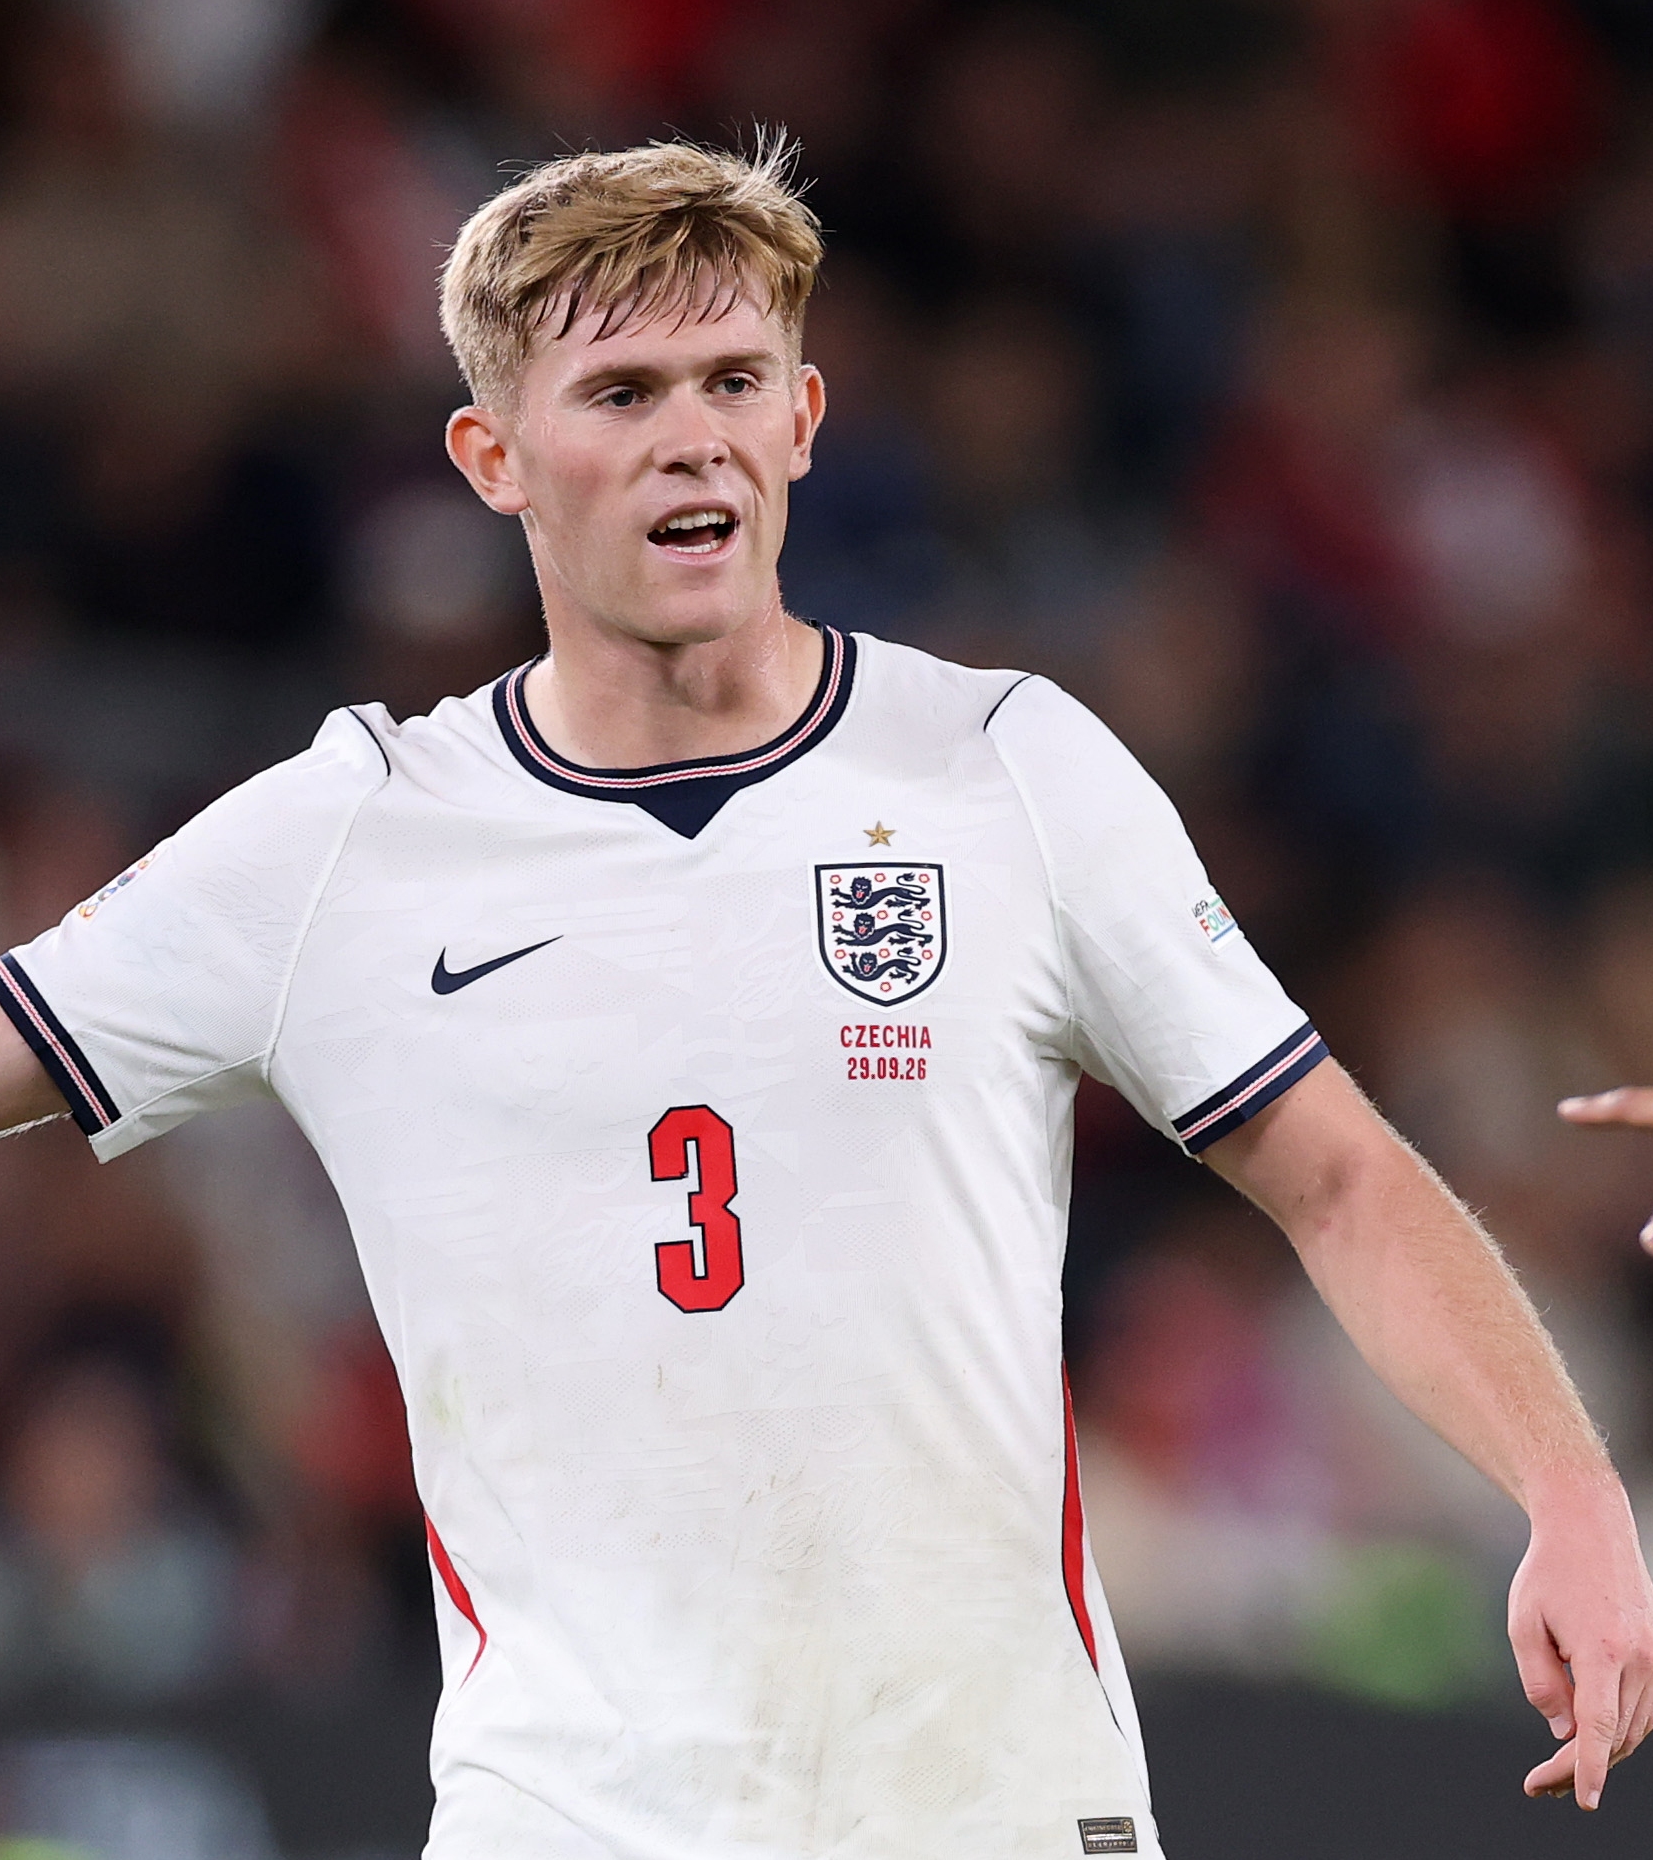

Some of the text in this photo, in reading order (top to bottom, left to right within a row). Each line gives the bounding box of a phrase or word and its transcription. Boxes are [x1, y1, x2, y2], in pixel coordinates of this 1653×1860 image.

[840, 1025, 932, 1049] CZECHIA
[847, 1056, 926, 1080] 29.09.26
[648, 1104, 745, 1314] 3
